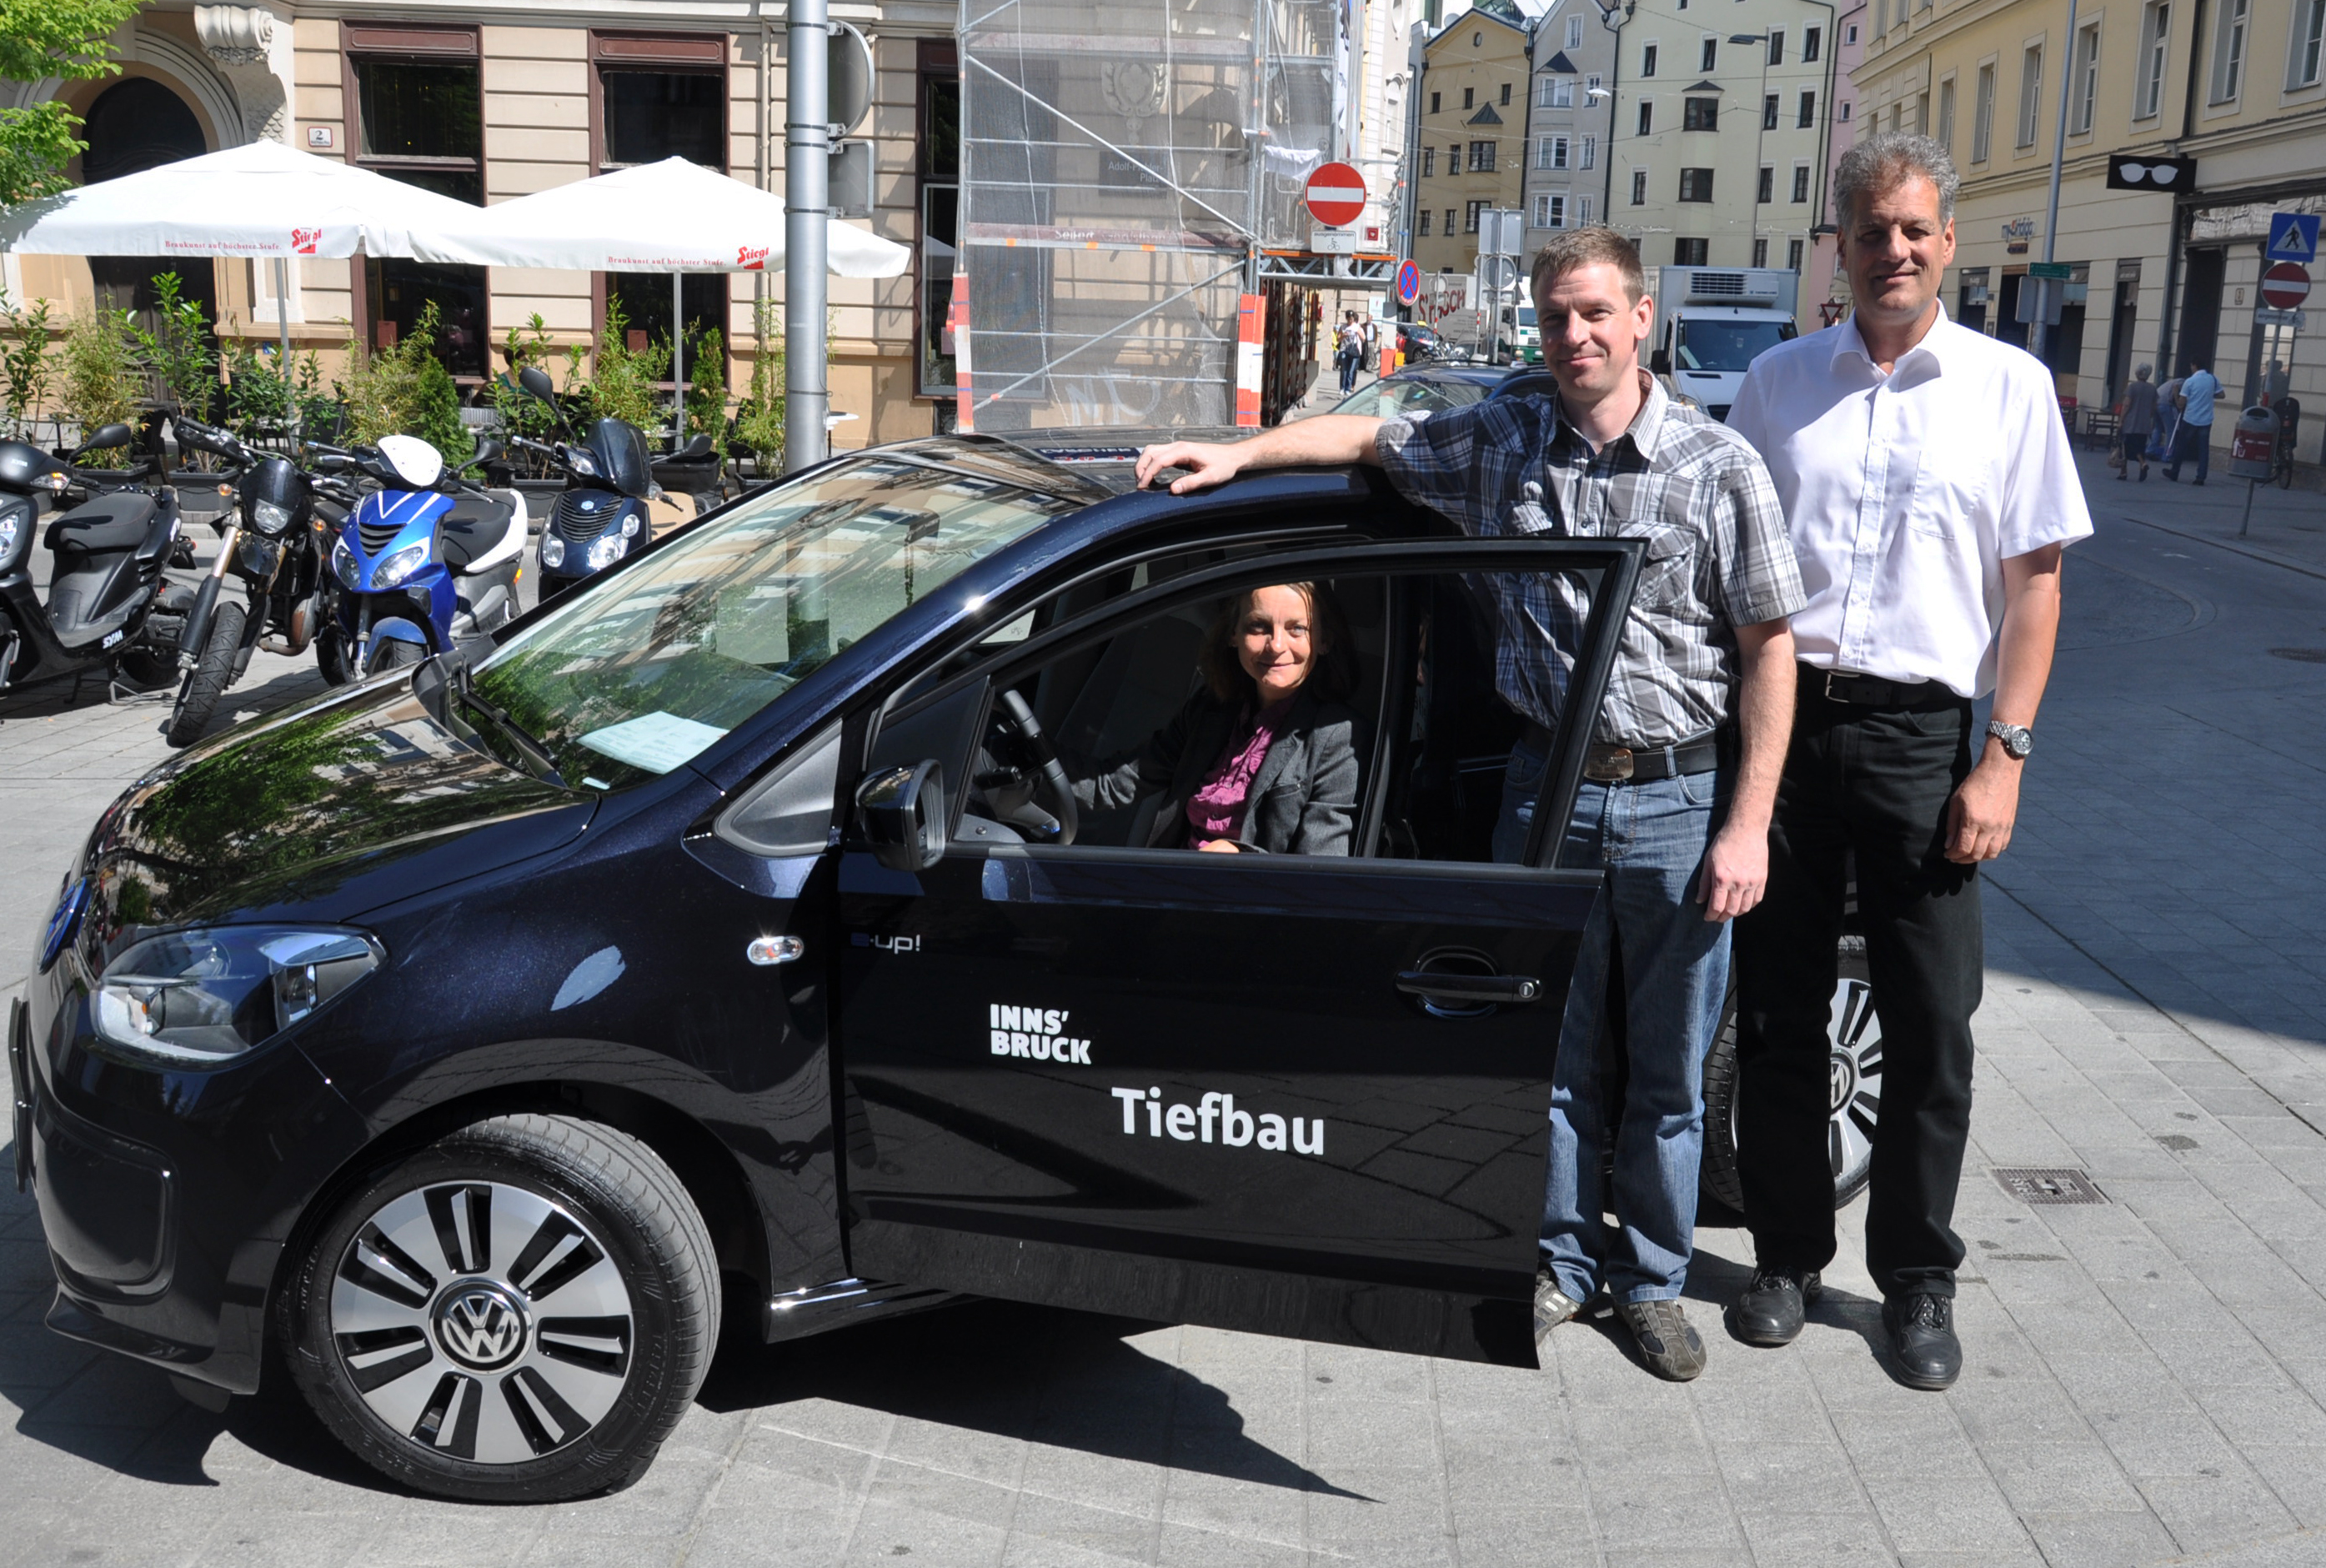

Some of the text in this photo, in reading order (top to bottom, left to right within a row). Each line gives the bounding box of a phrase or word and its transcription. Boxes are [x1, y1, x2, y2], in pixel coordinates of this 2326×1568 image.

[315, 130, 323, 140] 2
[165, 240, 206, 248] Braukunst
[208, 241, 223, 249] auf
[608, 255, 649, 264] Braukunst
[737, 246, 769, 264] Stiegl
[990, 1029, 1092, 1065] BRUCK
[1110, 1085, 1325, 1156] Tiefbau
